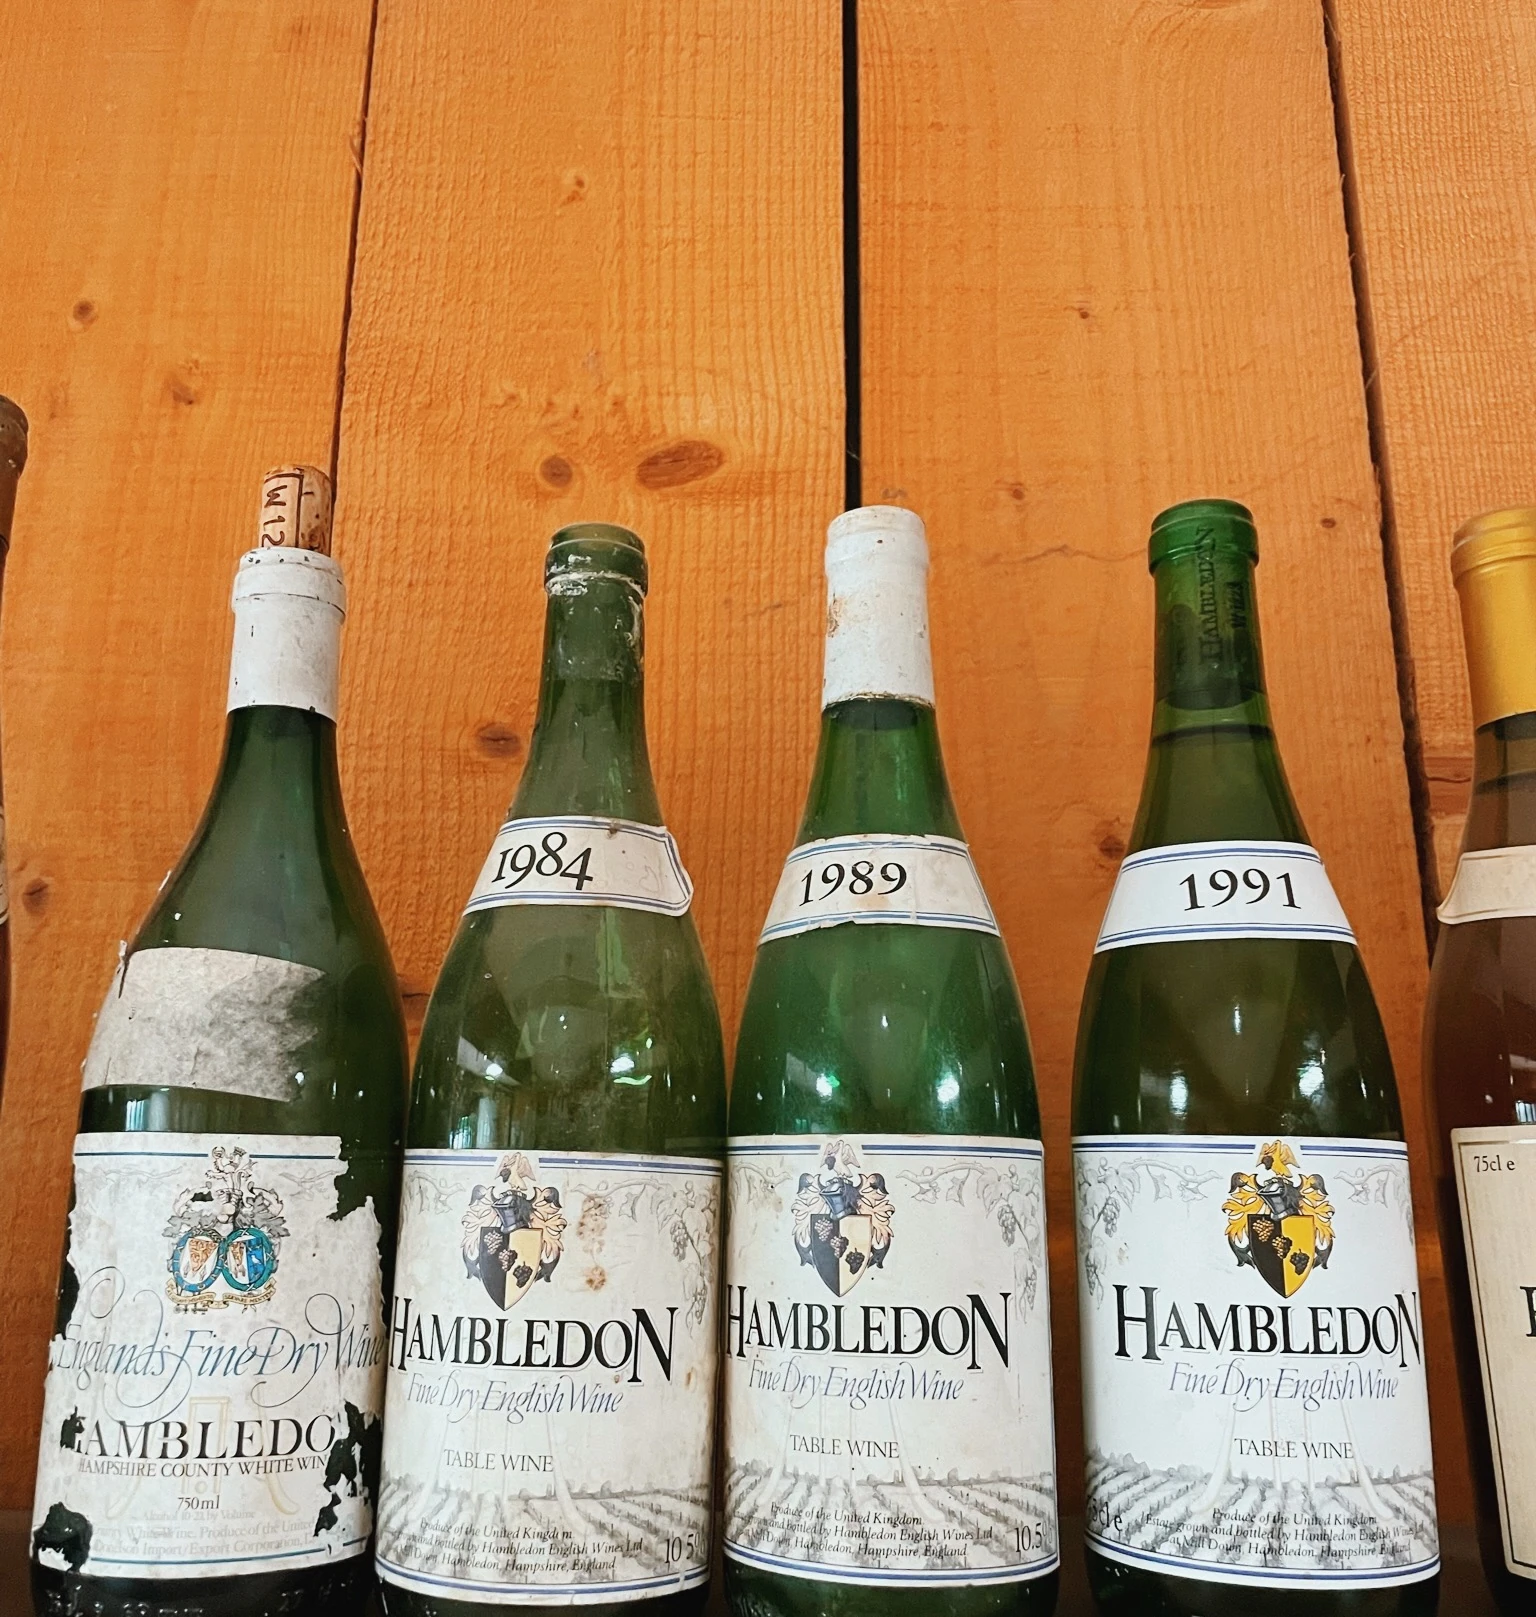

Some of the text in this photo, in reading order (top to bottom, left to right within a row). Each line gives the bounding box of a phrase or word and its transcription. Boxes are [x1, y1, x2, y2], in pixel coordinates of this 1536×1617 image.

[491, 831, 594, 891] 1984
[799, 862, 908, 907] 1989
[1179, 868, 1302, 911] 1991
[1474, 1155, 1516, 1172] 75cl e
[726, 1284, 1012, 1370] HAMBLEDON
[1112, 1284, 1420, 1368] HAMBLEDON
[389, 1295, 679, 1384] HAMBLEDON
[247, 1326, 329, 1408] Dry
[318, 1305, 385, 1370] Wine
[749, 1355, 964, 1411] Fine Dry English Wine
[1169, 1358, 1399, 1412] Fine Dry English Wine
[407, 1369, 624, 1424] Fine Dry English Wine
[78, 1414, 336, 1459] AMBLEDO
[789, 1434, 900, 1459] TABLE WINE
[1234, 1438, 1354, 1460] TABLE WINE
[78, 1454, 327, 1477] HAMPSHIRE COUNTY WHITE WIN
[443, 1448, 554, 1473] TABLE WINE
[177, 1495, 221, 1511] 750ml
[804, 1506, 815, 1522] of
[816, 1507, 831, 1520] the
[834, 1509, 870, 1524] United
[1212, 1507, 1257, 1523] Produce
[1259, 1511, 1270, 1526] of
[1273, 1511, 1289, 1525] the
[1294, 1513, 1331, 1526] United
[454, 1523, 465, 1539] of
[465, 1523, 480, 1536] the
[484, 1525, 519, 1539] United
[819, 1521, 832, 1538] by
[834, 1526, 897, 1540] Hambledon
[900, 1528, 939, 1543] English
[943, 1529, 974, 1540] Wines
[1211, 1524, 1232, 1536] and
[1235, 1524, 1274, 1540] bottled
[1294, 1528, 1357, 1542] Hambledon
[482, 1541, 546, 1556] Hambledon
[549, 1541, 588, 1558] English
[592, 1541, 624, 1554] Wines
[858, 1543, 921, 1560] Hampshire,
[504, 1558, 569, 1575] Hampshire,
